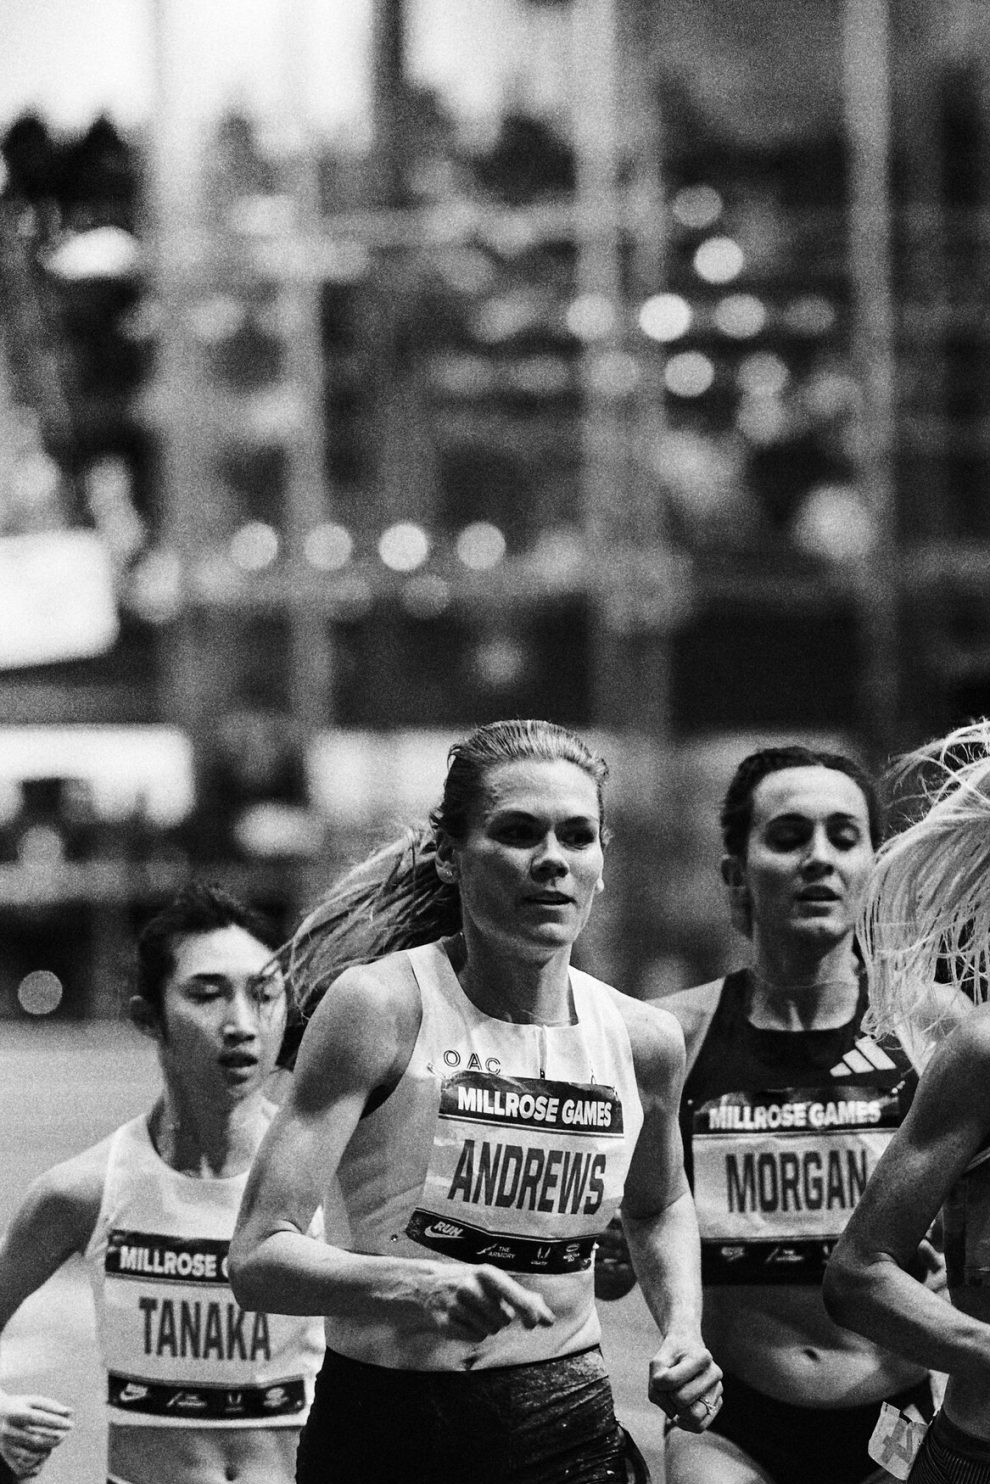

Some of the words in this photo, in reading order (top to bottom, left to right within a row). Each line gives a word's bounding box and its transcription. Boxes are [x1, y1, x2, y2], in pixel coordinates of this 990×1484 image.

[443, 1050, 501, 1075] OAC
[458, 1086, 558, 1122] MILLROSE
[561, 1098, 612, 1128] GAMES
[709, 1102, 807, 1130] MILLROSE
[808, 1100, 881, 1127] GAMES
[447, 1139, 606, 1215] ANDREWS
[725, 1149, 867, 1213] MORGAN
[433, 1221, 464, 1237] RUN
[119, 1245, 216, 1277] MILLROSE
[139, 1297, 271, 1361] TANAKA
